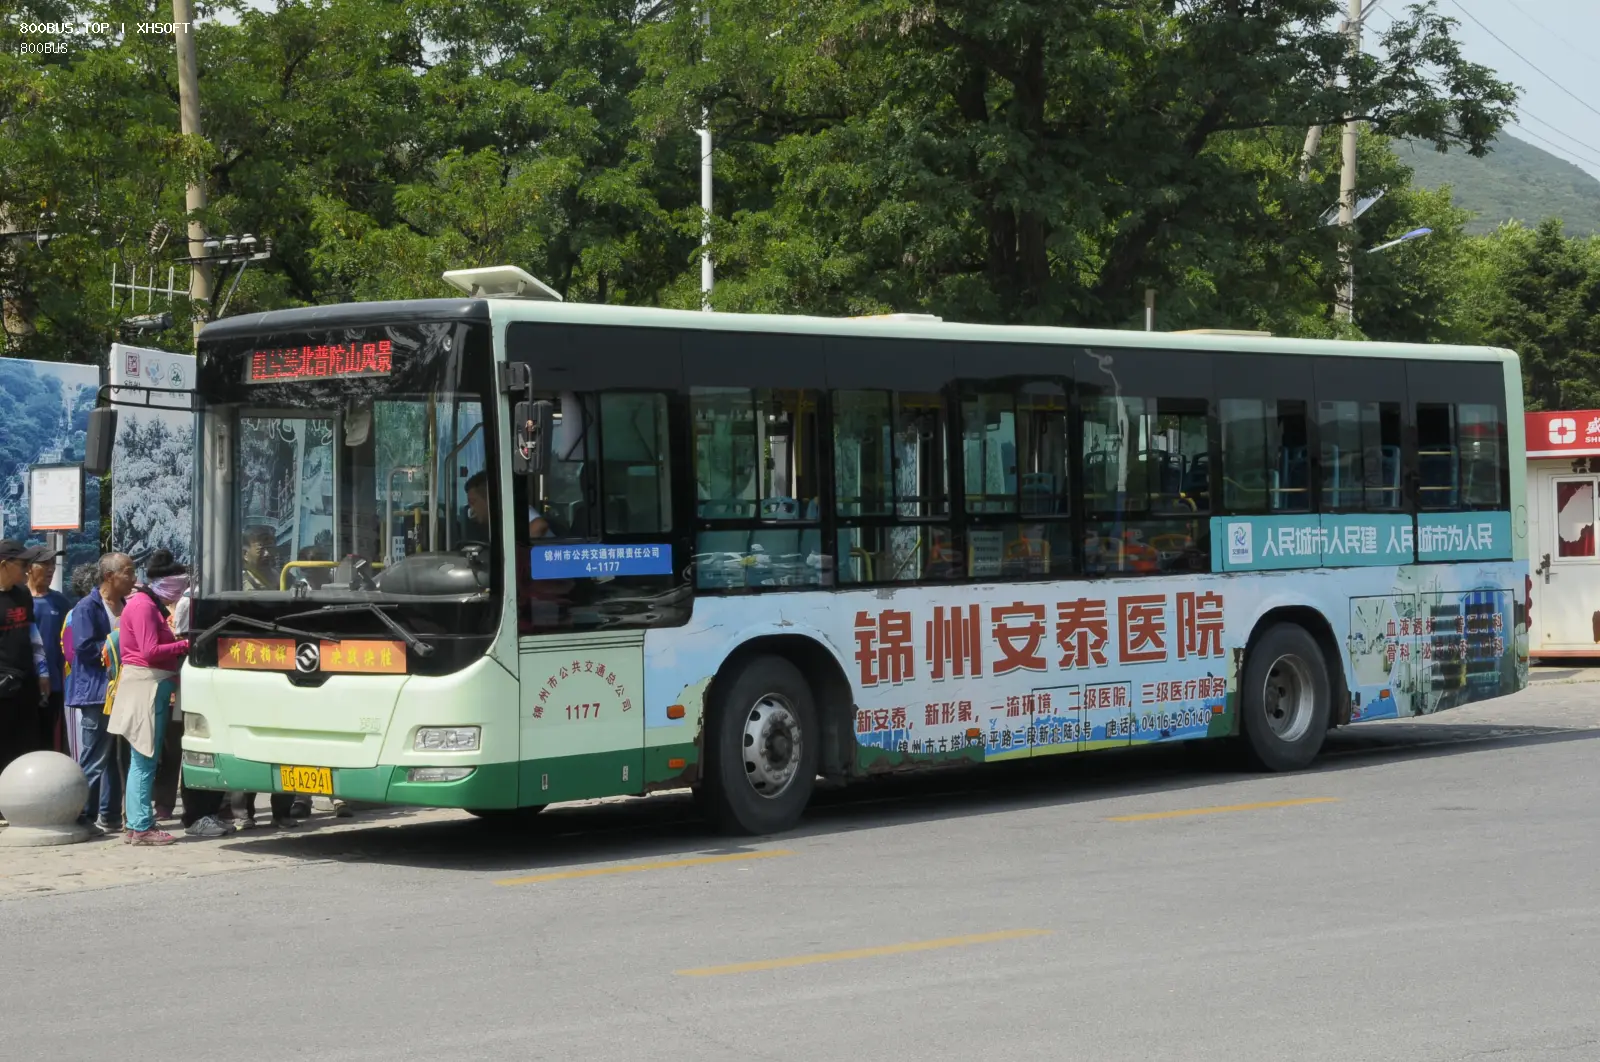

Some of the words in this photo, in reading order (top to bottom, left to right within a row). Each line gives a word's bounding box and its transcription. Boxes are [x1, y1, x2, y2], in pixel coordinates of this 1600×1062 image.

[1262, 526, 1377, 557] 人民城市人民建
[1386, 523, 1492, 554] 人民城市为人民
[544, 547, 660, 562] 锦州市公共交通有限责任公司
[586, 561, 620, 573] 4-1177
[854, 591, 1226, 686] 锦州安泰医院
[532, 660, 632, 719] 锦州市公共交通总公司
[565, 702, 601, 720] 1177
